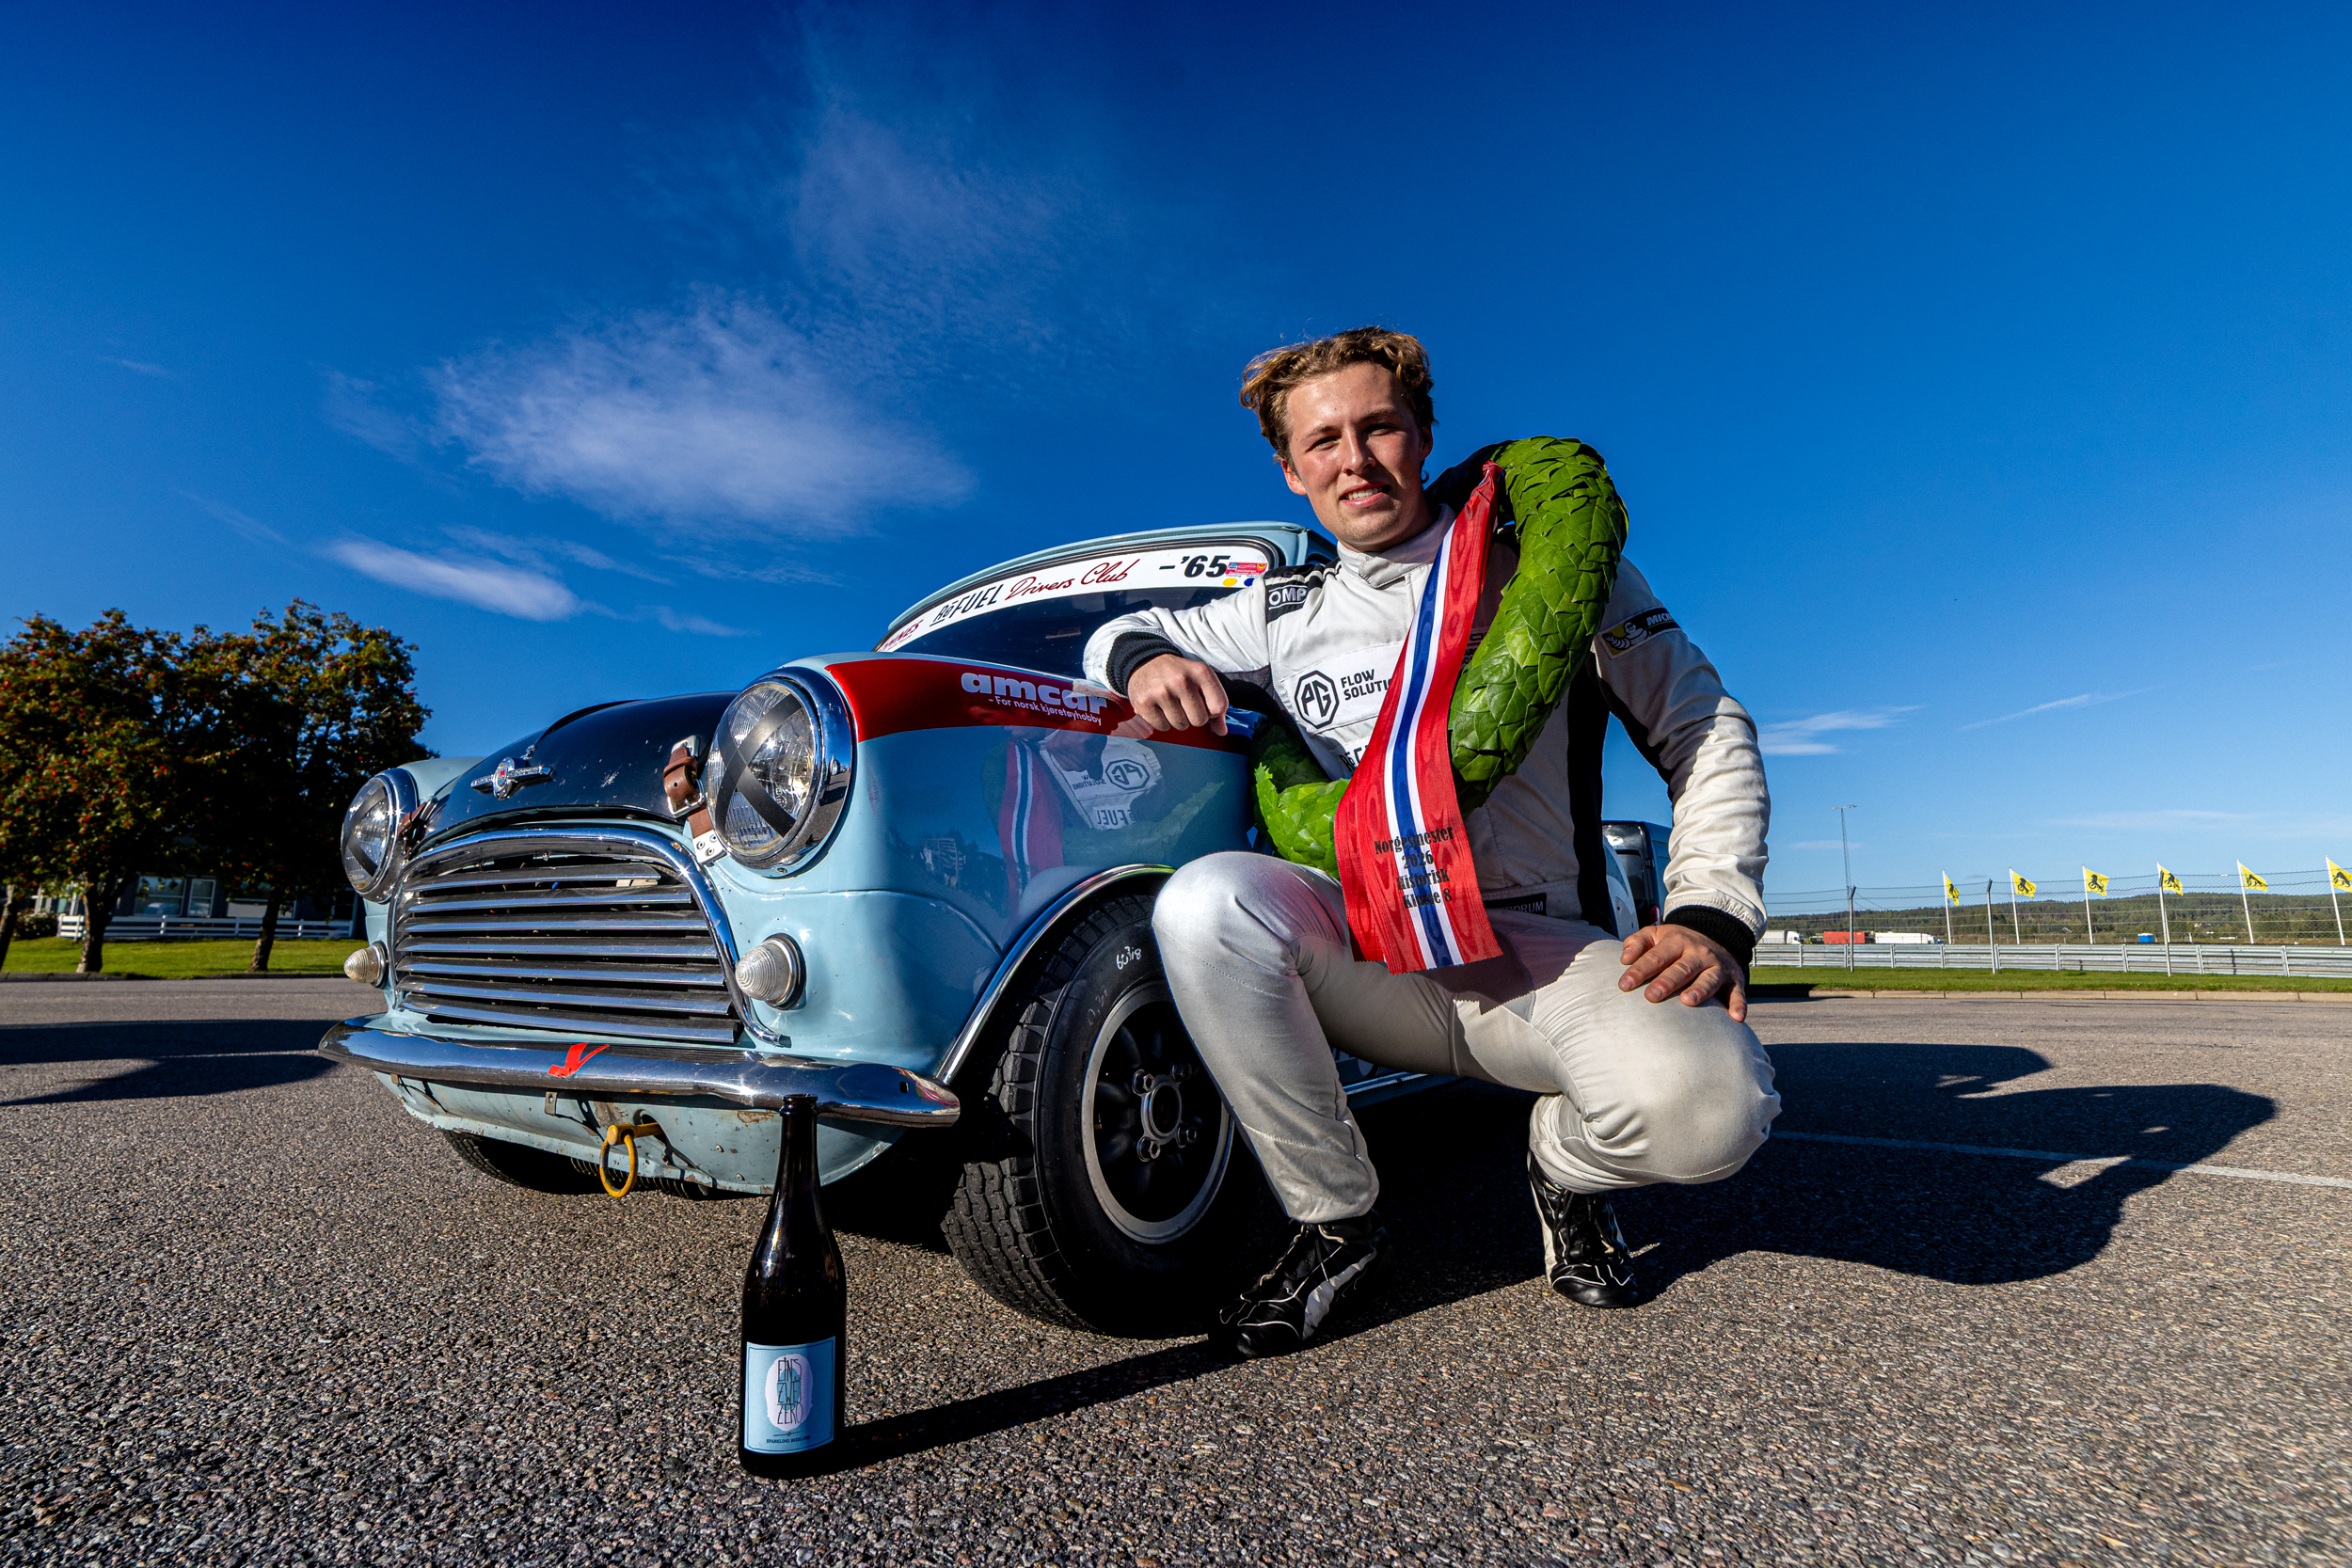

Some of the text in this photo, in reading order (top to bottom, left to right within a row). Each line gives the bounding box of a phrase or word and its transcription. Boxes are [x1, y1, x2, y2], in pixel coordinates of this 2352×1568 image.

[1005, 576, 1075, 601] Drivers
[1080, 559, 1140, 585] Club
[1269, 588, 1307, 606] OMP
[1341, 669, 1375, 689] FLOW
[961, 673, 1107, 714] amcar
[994, 696, 1011, 706] For
[1013, 699, 1041, 712] norsk
[1374, 827, 1454, 855] Norgesmester
[1402, 850, 1434, 870] 2026
[1395, 868, 1451, 891] Historisk
[1403, 887, 1453, 909] Klasse 8
[777, 1402, 803, 1425] ZERO
